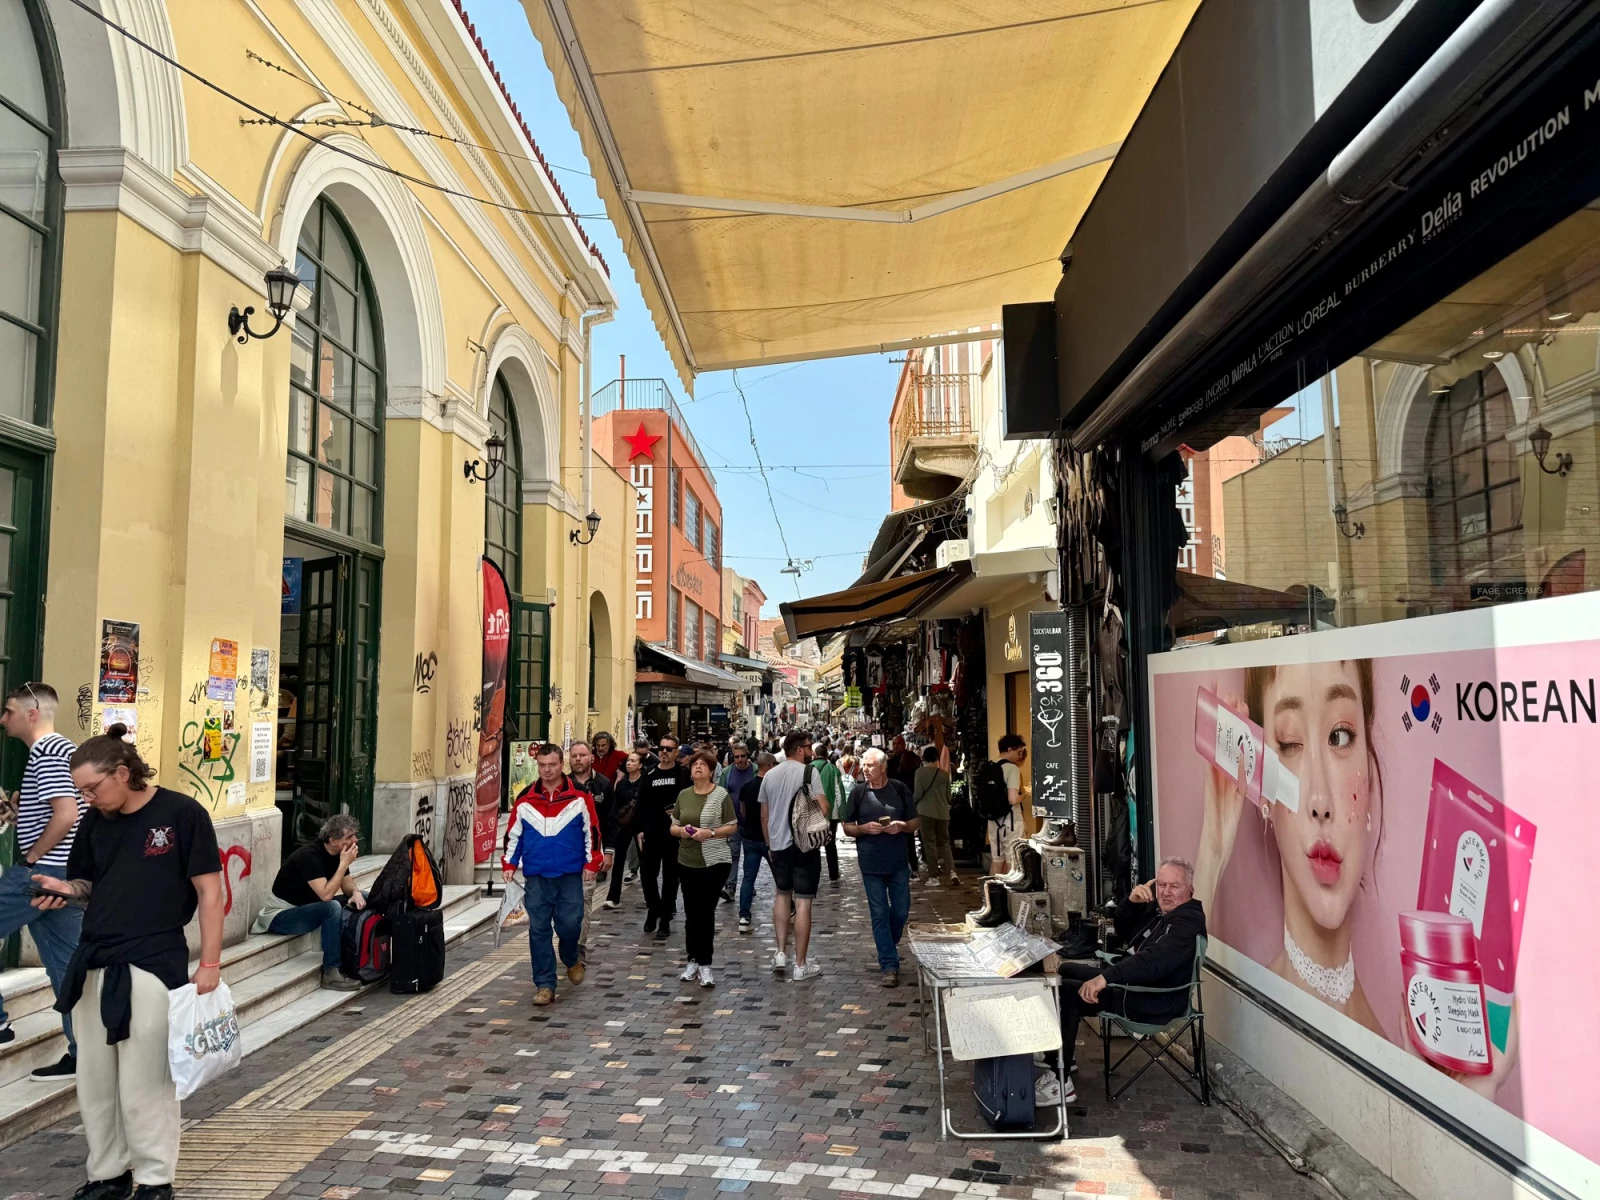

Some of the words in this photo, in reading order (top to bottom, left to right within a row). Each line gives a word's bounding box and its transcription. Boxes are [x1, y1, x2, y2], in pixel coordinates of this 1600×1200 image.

[1470, 104, 1570, 200] REVOLUTION
[1422, 210, 1463, 245] COSMETICS
[1344, 228, 1417, 297] BURBERRY
[1297, 291, 1341, 336] L'ORÉAL
[1257, 321, 1295, 359] L'ACTION
[1231, 353, 1258, 384] IMPALA
[1205, 374, 1230, 402] INGRID
[1505, 586, 1543, 595] CREAMS
[1456, 678, 1597, 725] KOREAN
[1045, 762, 1059, 770] CAFE
[1410, 981, 1442, 1044] WATERMELON
[1448, 1005, 1468, 1020] Sleeping
[1468, 1008, 1480, 1017] Mask
[1452, 995, 1467, 1006] Hydro
[1467, 995, 1479, 1005] Vital
